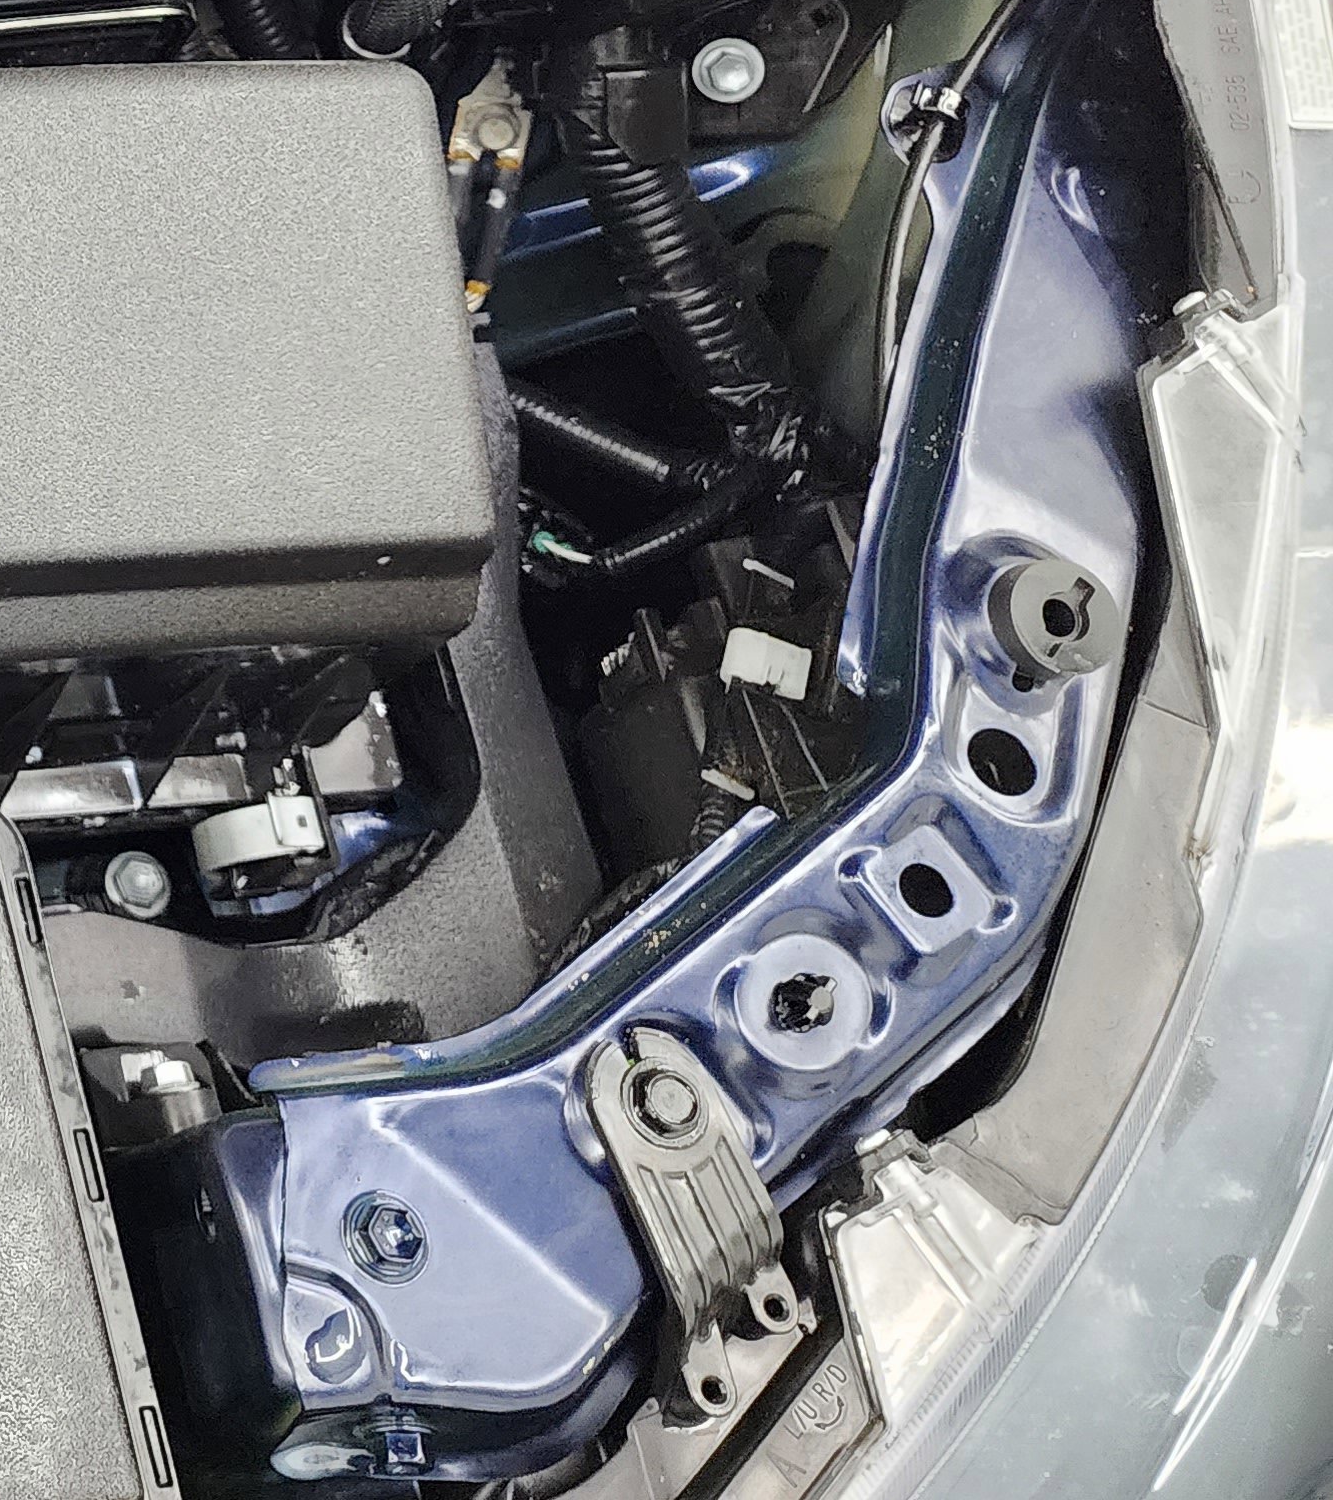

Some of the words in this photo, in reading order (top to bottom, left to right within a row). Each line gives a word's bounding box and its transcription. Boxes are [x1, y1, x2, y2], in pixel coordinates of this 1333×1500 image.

[812, 1363, 848, 1402] R/D
[783, 1402, 818, 1440] L/U
[766, 1451, 807, 1489] A
